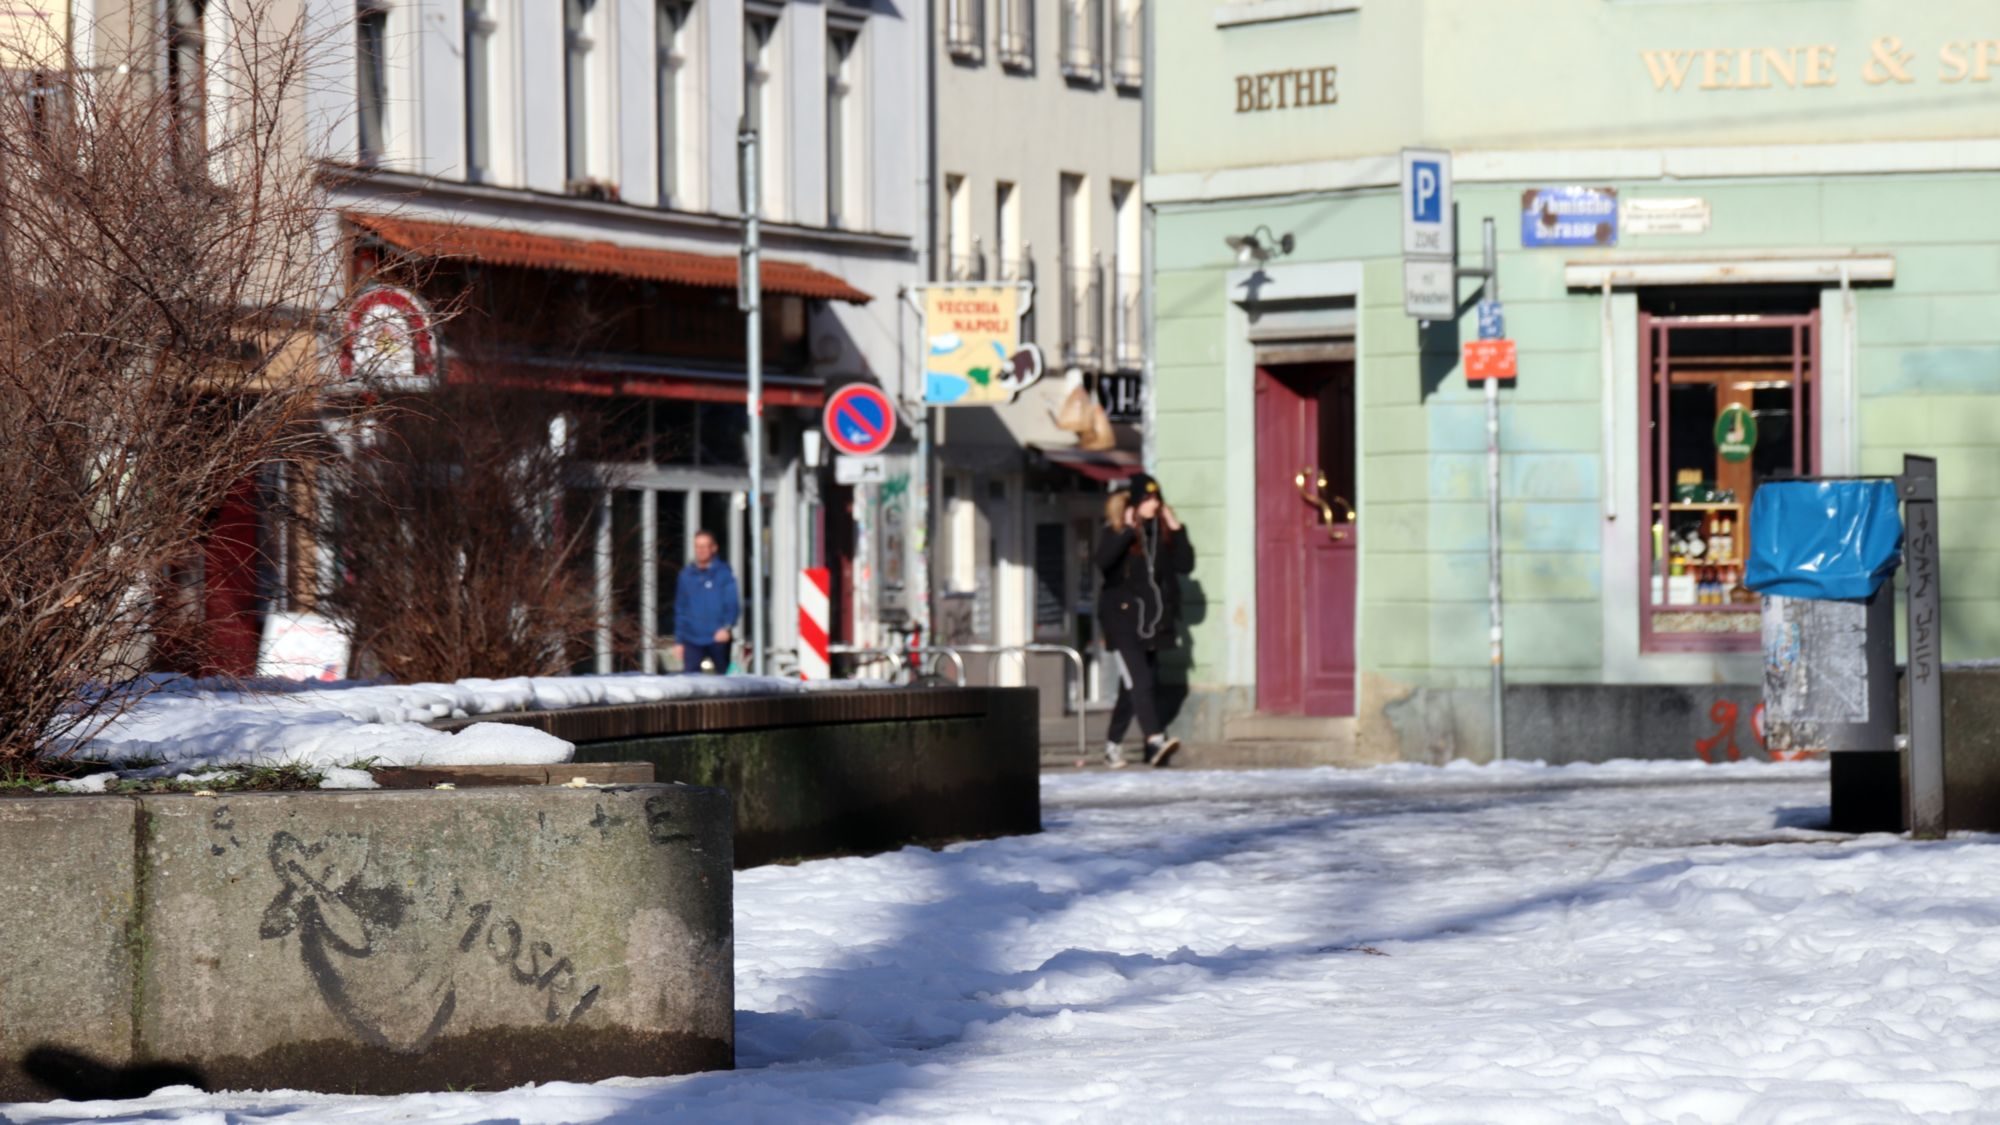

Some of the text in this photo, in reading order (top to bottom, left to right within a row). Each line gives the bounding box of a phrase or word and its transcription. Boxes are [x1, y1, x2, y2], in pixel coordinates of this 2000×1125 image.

[1640, 44, 1838, 92] WEINE
[1861, 35, 1916, 85] &
[1234, 65, 1339, 114] BETHE
[1416, 167, 1436, 217] P
[1414, 231, 1441, 249] ZONE
[937, 301, 1000, 314] VECCHIA
[953, 320, 1009, 333] NAPOLI
